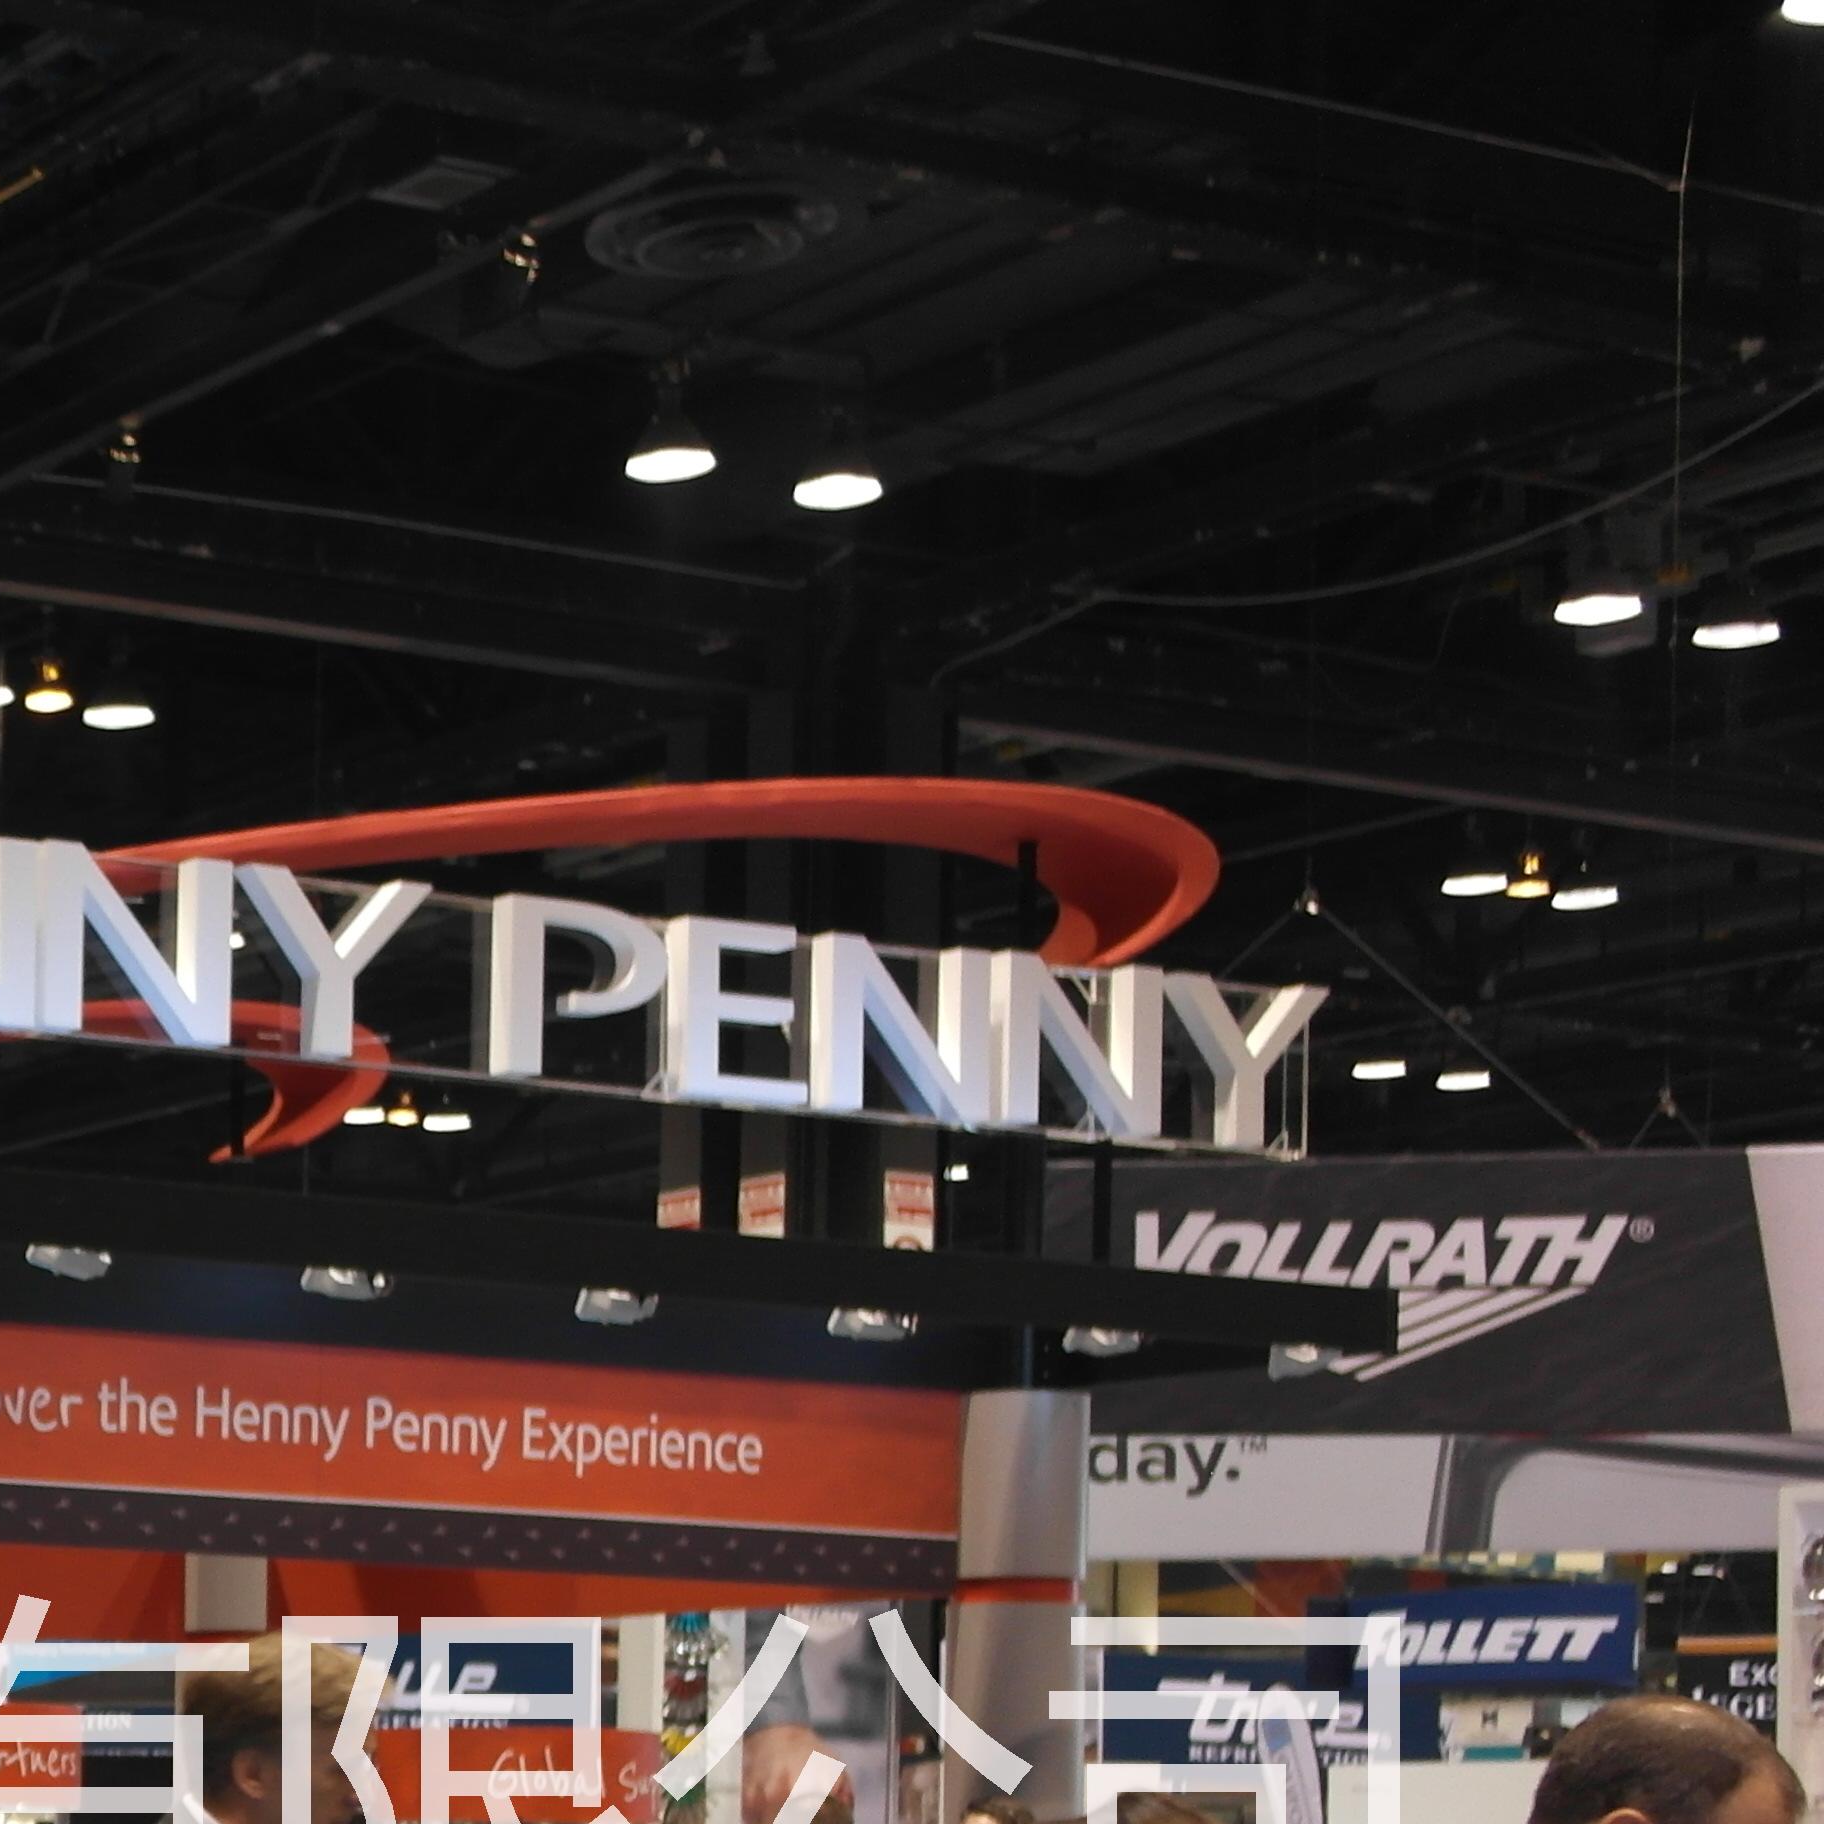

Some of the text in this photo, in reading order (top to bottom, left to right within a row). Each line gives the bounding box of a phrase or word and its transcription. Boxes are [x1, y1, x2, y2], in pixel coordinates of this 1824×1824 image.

[489, 892, 1330, 1150] PENNY
[98, 1377, 177, 1437] the
[195, 1385, 349, 1462] Henny
[365, 1396, 507, 1472] Penny
[522, 1407, 763, 1477] Experience
[1354, 1607, 1620, 1671] FOLLETT
[487, 1744, 607, 1800] Global
